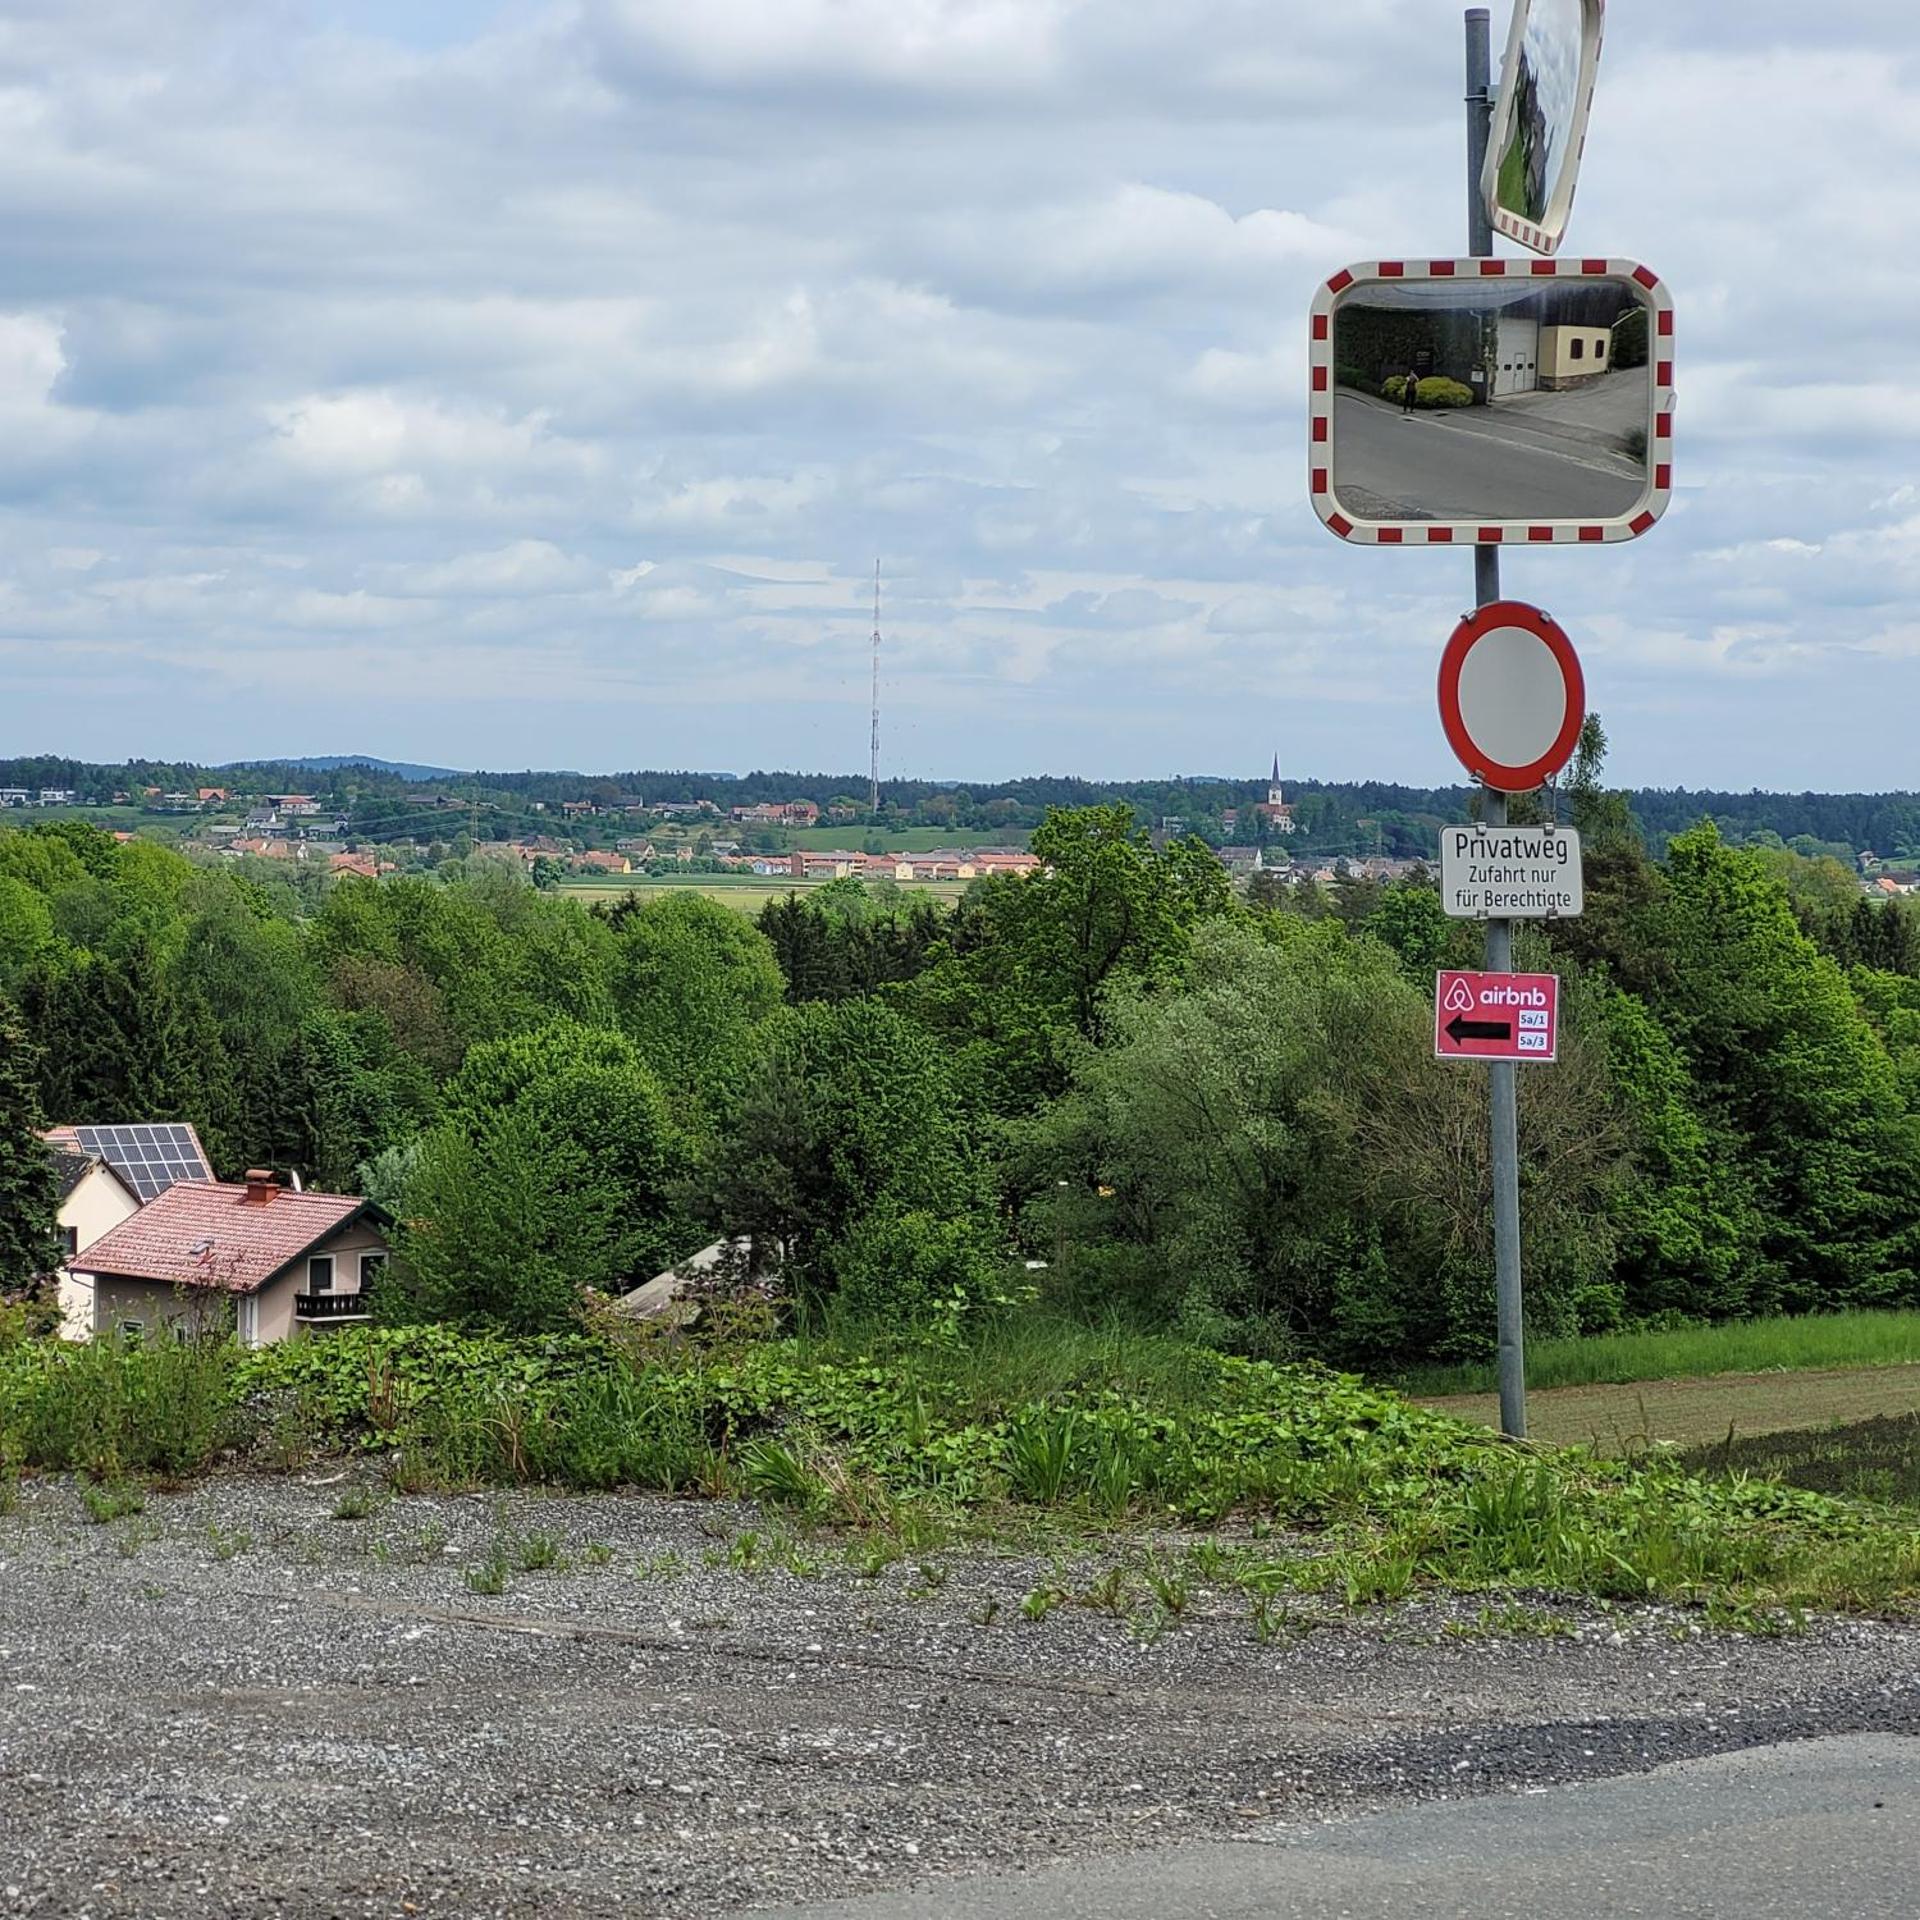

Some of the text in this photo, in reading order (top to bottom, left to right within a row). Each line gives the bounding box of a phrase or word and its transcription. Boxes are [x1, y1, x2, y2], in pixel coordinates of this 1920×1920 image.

[1456, 833, 1568, 864] Privatweg
[1469, 866, 1557, 883] Zufahrt nur
[1456, 889, 1571, 910] für Berechtigte
[1480, 986, 1546, 1006] airbnb
[1520, 1014, 1545, 1025] 5a/1
[1519, 1036, 1544, 1047] 5a/3
